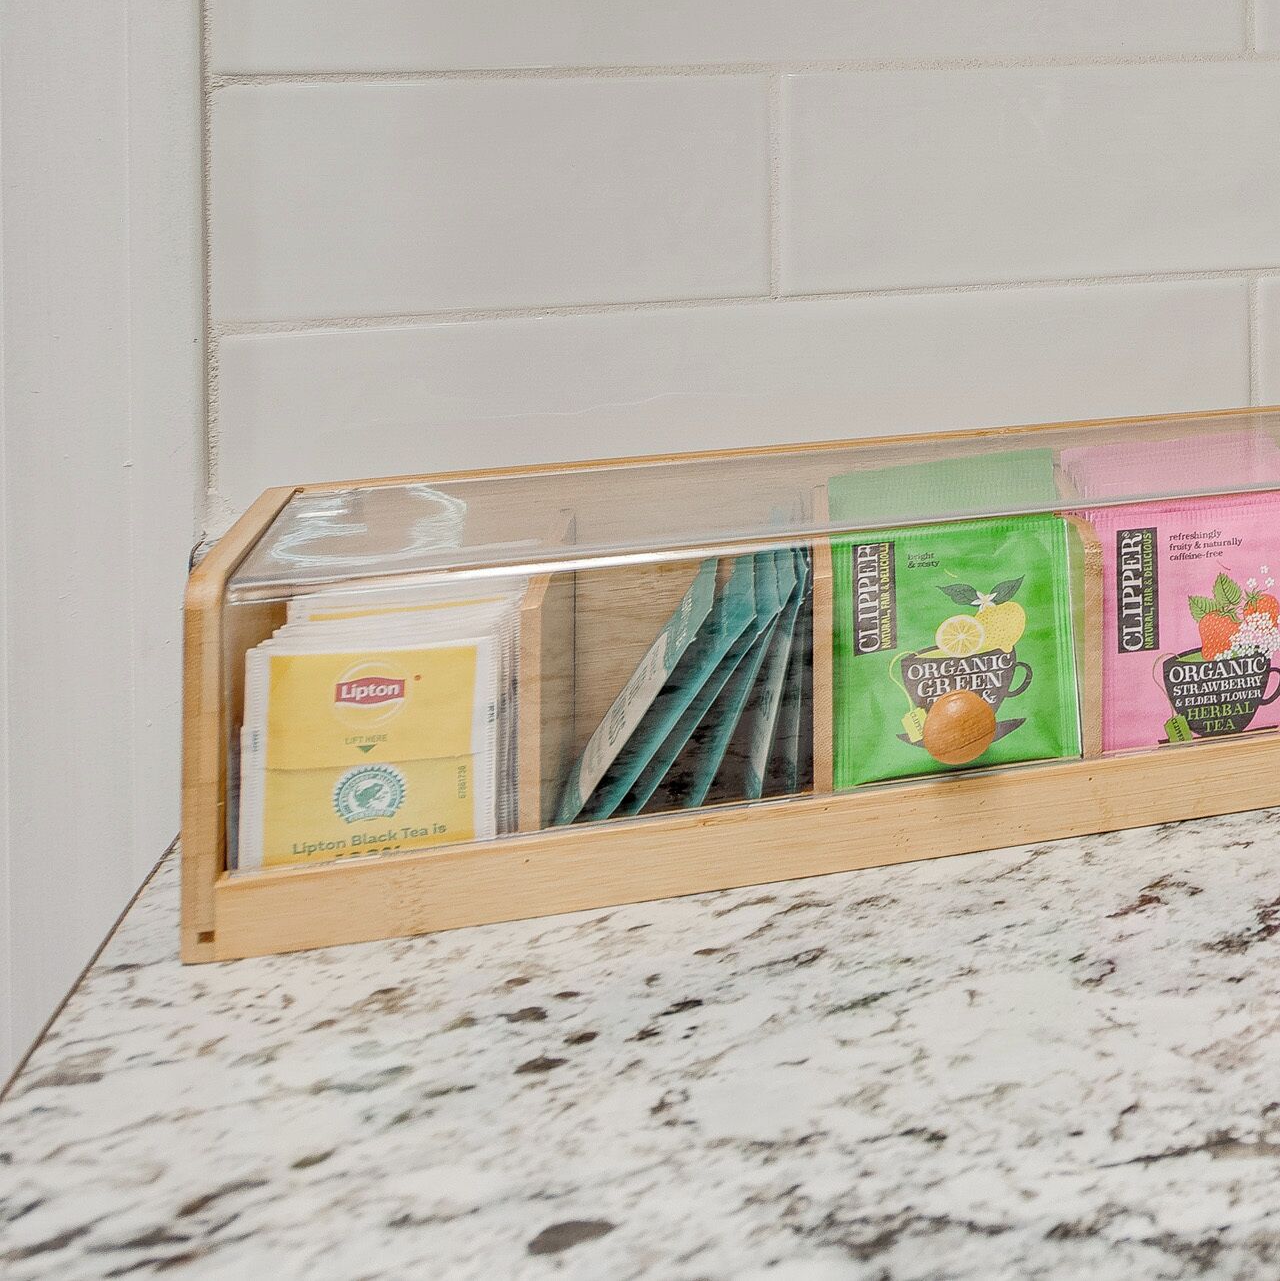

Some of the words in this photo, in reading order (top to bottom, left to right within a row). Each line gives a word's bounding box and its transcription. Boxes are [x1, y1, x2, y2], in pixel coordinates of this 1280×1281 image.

[1169, 530, 1222, 541] refreshingly
[1169, 542, 1192, 551] fruity
[1194, 542, 1201, 550] &
[1203, 538, 1243, 549] naturally
[907, 552, 935, 561] bright
[1143, 533, 1152, 577] DELICIOUS
[1169, 550, 1223, 562] caffeine-free
[907, 561, 915, 569] &
[917, 560, 940, 568] zesty
[881, 592, 890, 608] FAIR
[1122, 533, 1143, 650] CLIPPER
[1144, 587, 1152, 605] FAIR
[880, 609, 891, 648] NATURAL,
[1144, 607, 1154, 648] NATURAL,
[907, 654, 1014, 681] ORGANIC
[1168, 656, 1267, 684] ORGANIC
[341, 683, 399, 700] Lipton
[917, 671, 1004, 698] GREEN
[1173, 675, 1263, 696] STRAWBERRY
[1175, 699, 1183, 707] &
[1184, 694, 1217, 707] ELDER
[1220, 689, 1261, 702] FLOWER
[1187, 702, 1255, 721] HERBAL
[1203, 718, 1236, 733] TEA
[344, 737, 362, 745] LIFT
[364, 734, 387, 743] HERE
[292, 838, 346, 855] Lipton
[351, 831, 397, 847] Black
[401, 828, 428, 838] Tea
[433, 824, 447, 833] is
